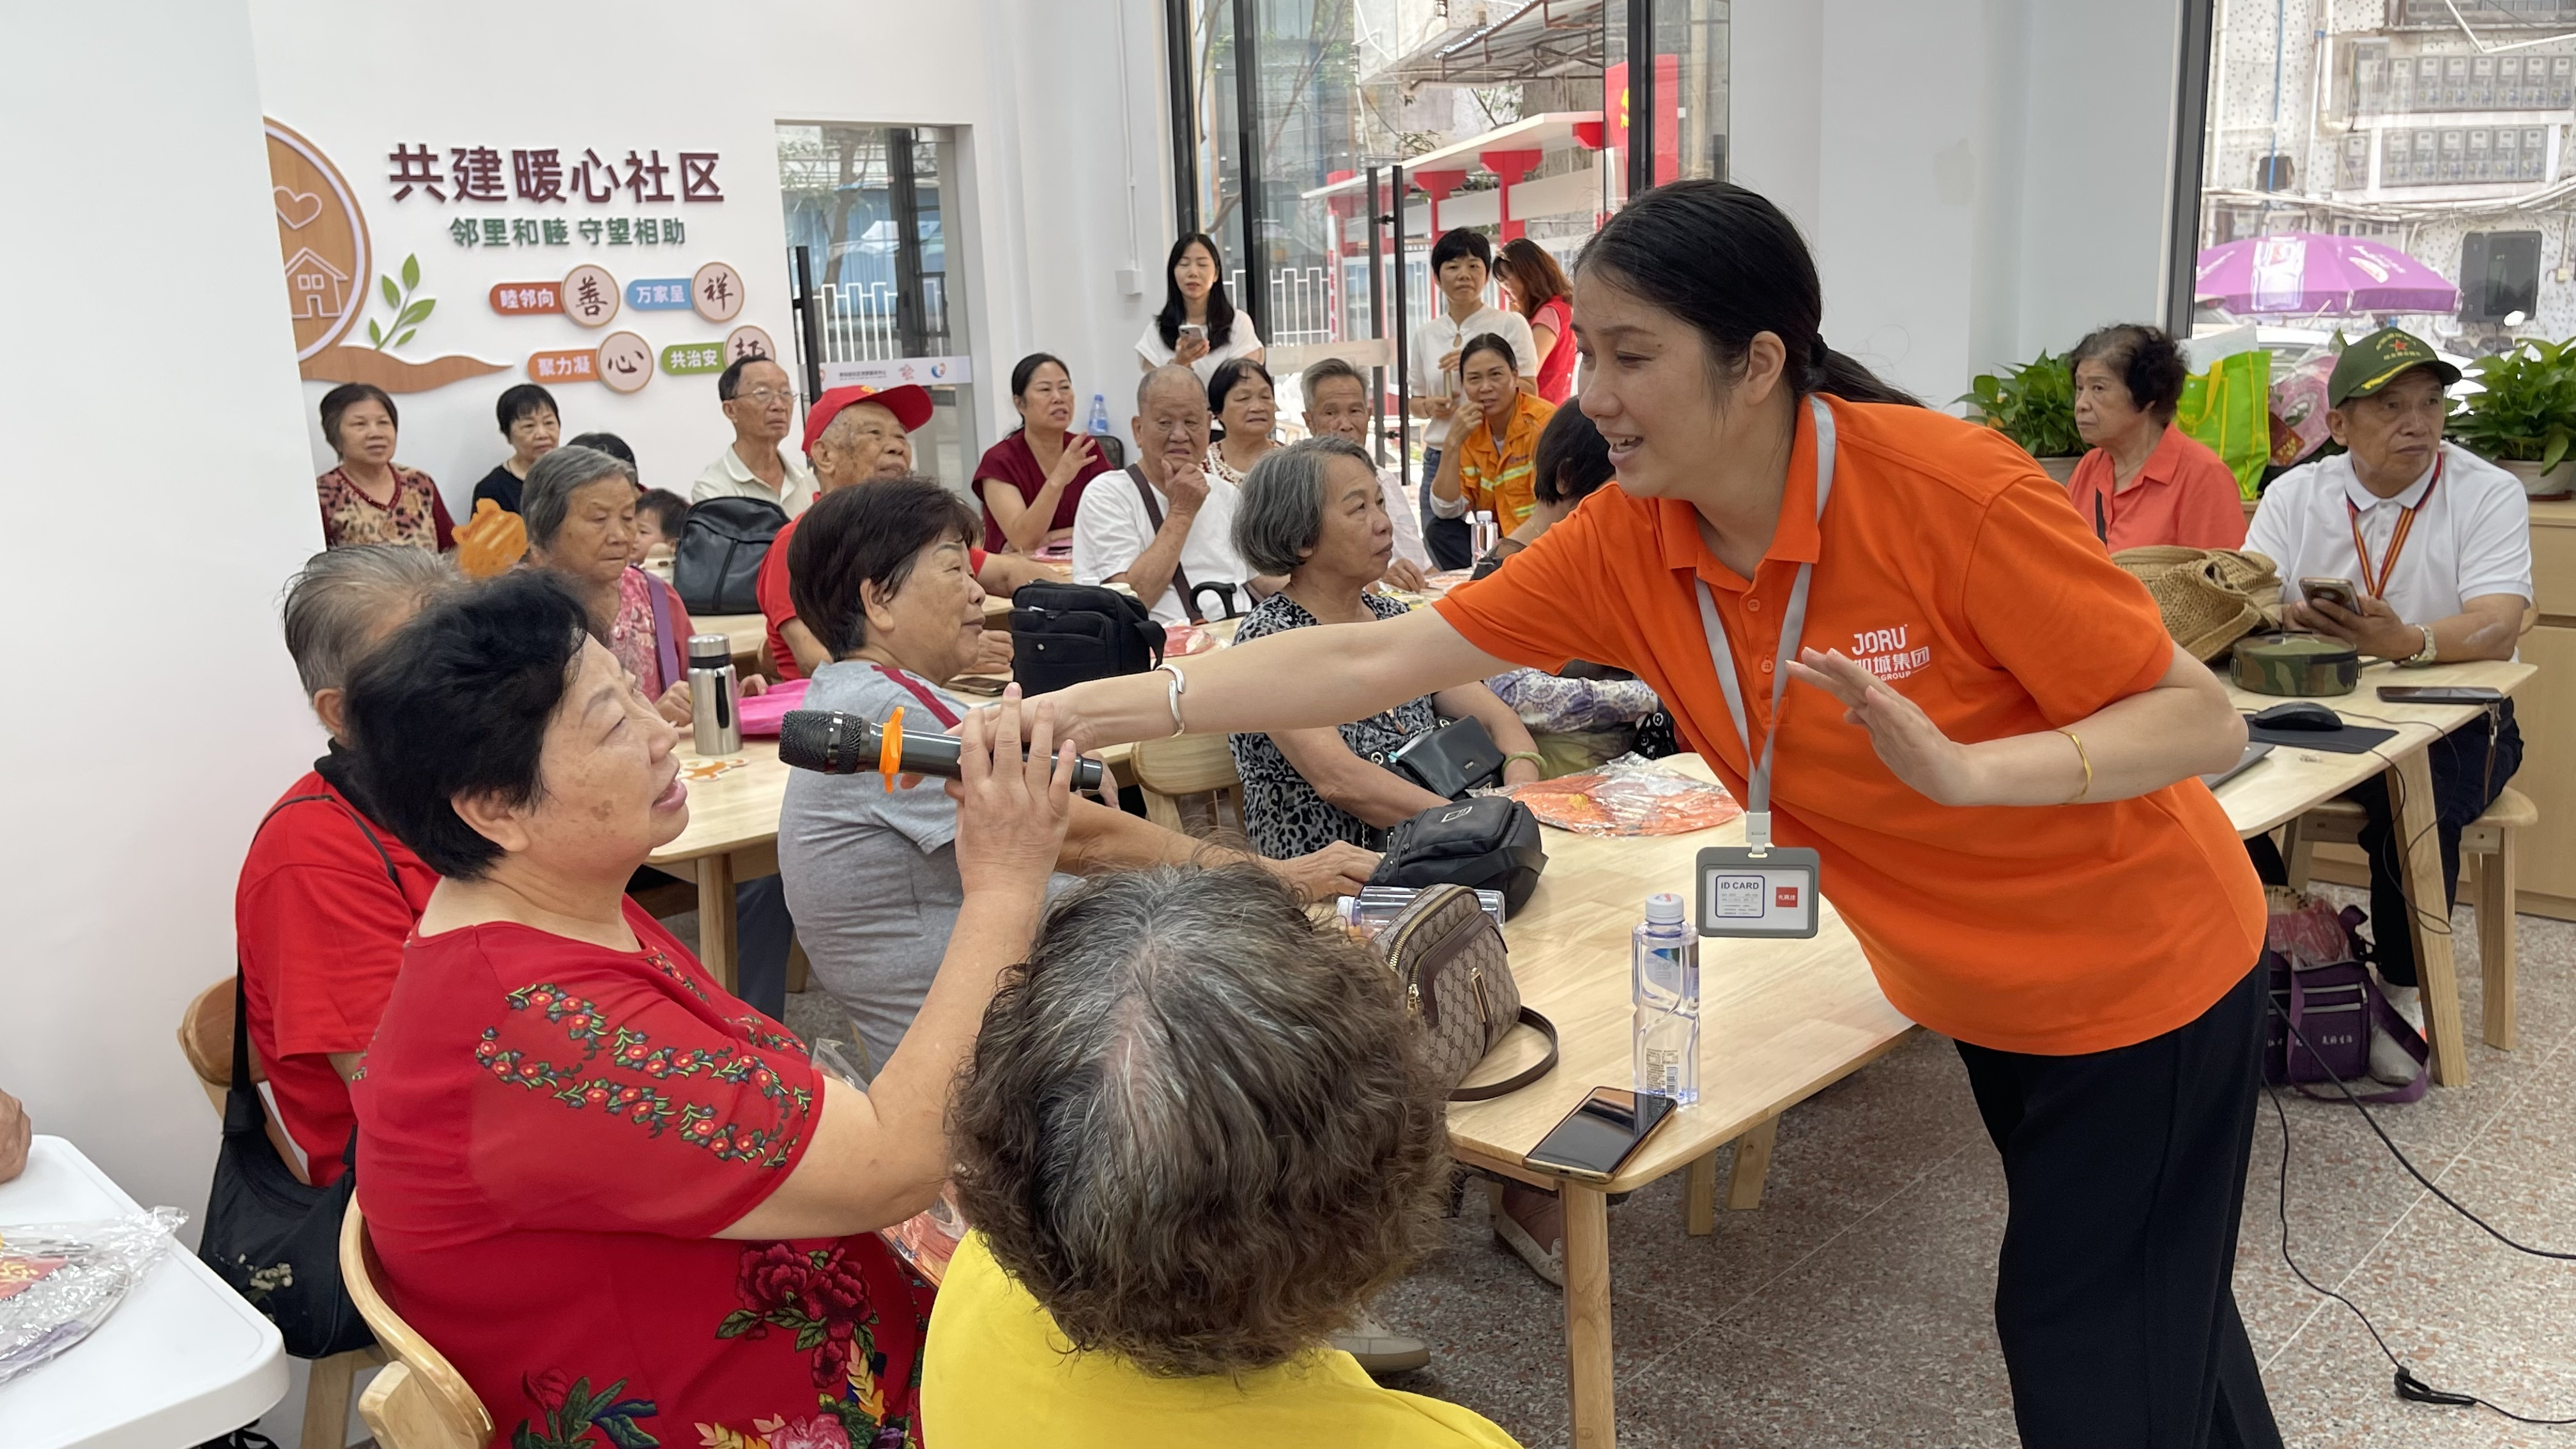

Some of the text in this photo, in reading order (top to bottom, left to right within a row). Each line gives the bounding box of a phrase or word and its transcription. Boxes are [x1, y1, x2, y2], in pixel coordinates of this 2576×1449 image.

[388, 143, 724, 203] 共建暖心社区
[450, 217, 686, 247] 邻里和睦 守望相助
[1851, 627, 1906, 656] JORU
[1881, 671, 1911, 681] GROUP
[1721, 882, 1759, 890] ID CARD
